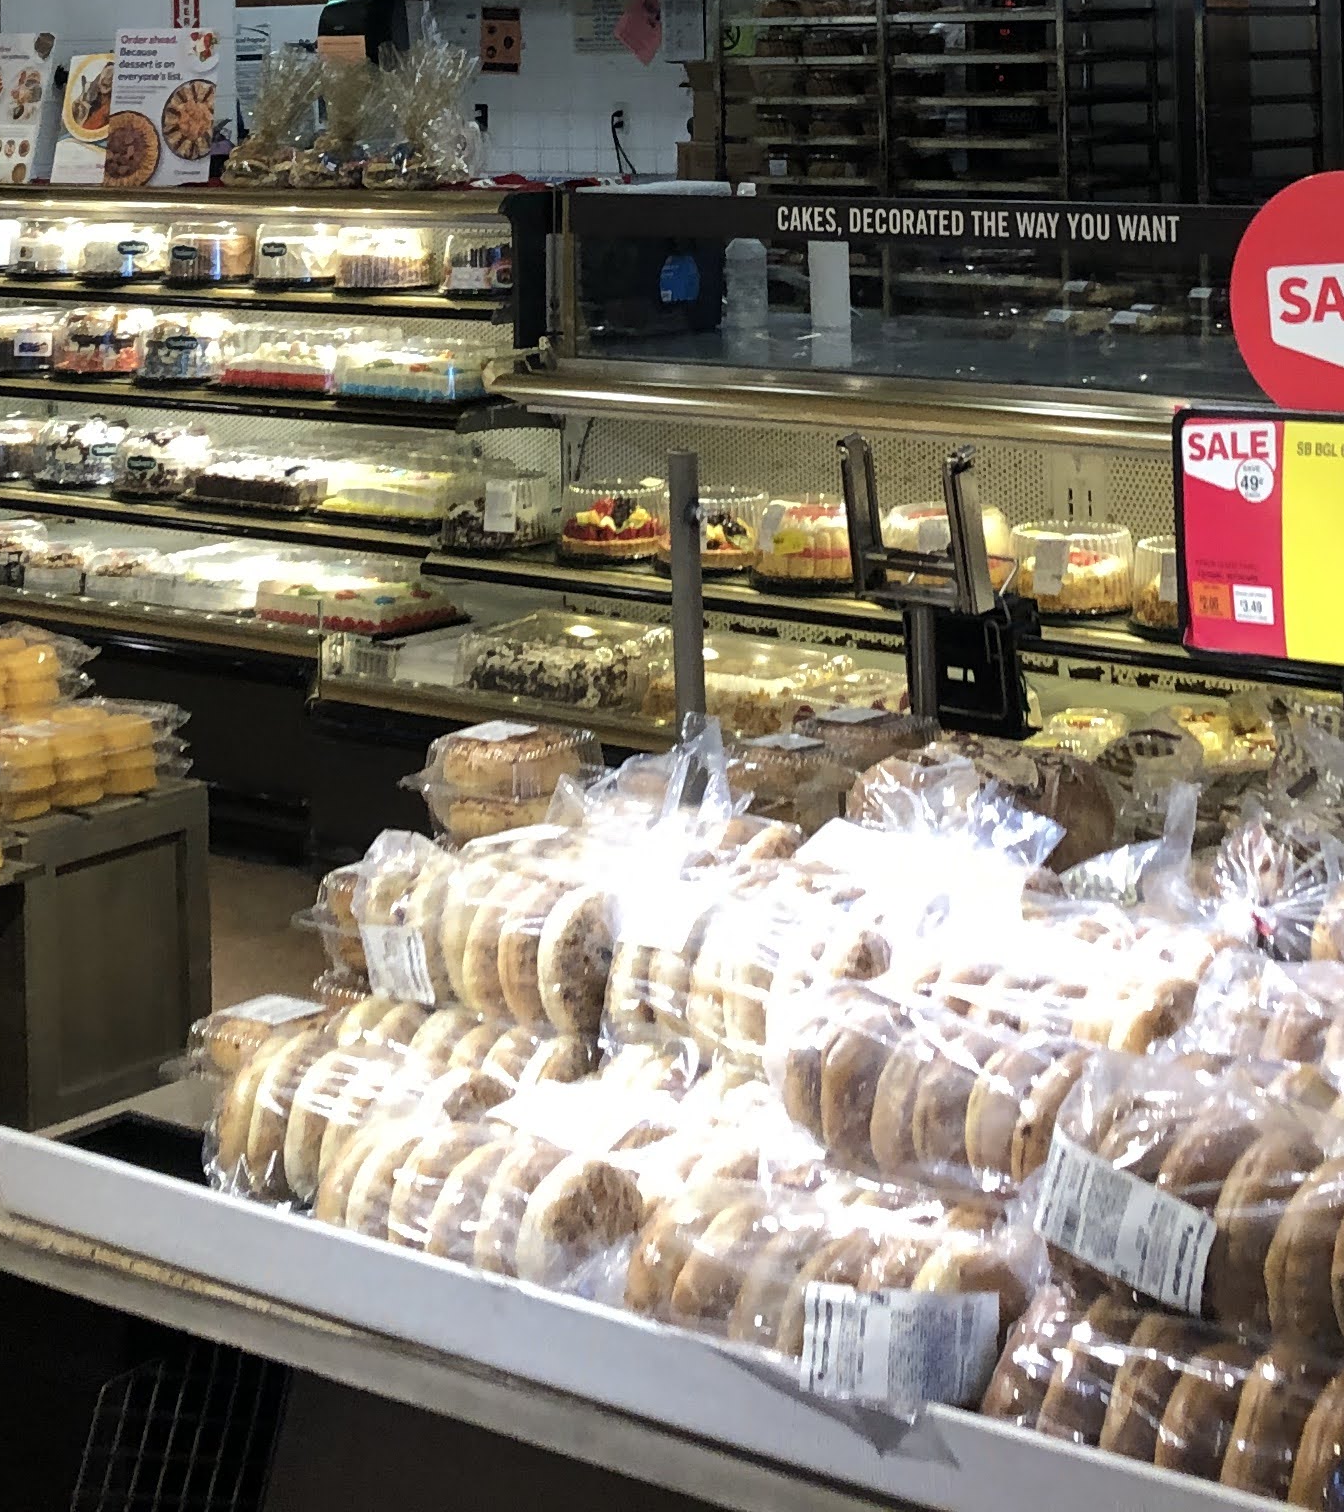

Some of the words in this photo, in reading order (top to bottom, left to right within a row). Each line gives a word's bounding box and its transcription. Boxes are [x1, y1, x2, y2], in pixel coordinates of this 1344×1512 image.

[120, 48, 158, 57] Because
[119, 60, 153, 69] dessert
[777, 206, 842, 235] CAKES,
[849, 207, 964, 236] DECORATED
[971, 210, 1009, 237] THE
[1016, 212, 1059, 239] WAY
[1067, 213, 1110, 241] YOU
[1117, 215, 1180, 243] WANT
[1187, 430, 1269, 461] SALE
[1297, 441, 1312, 456] SB
[1315, 442, 1338, 458] BGL
